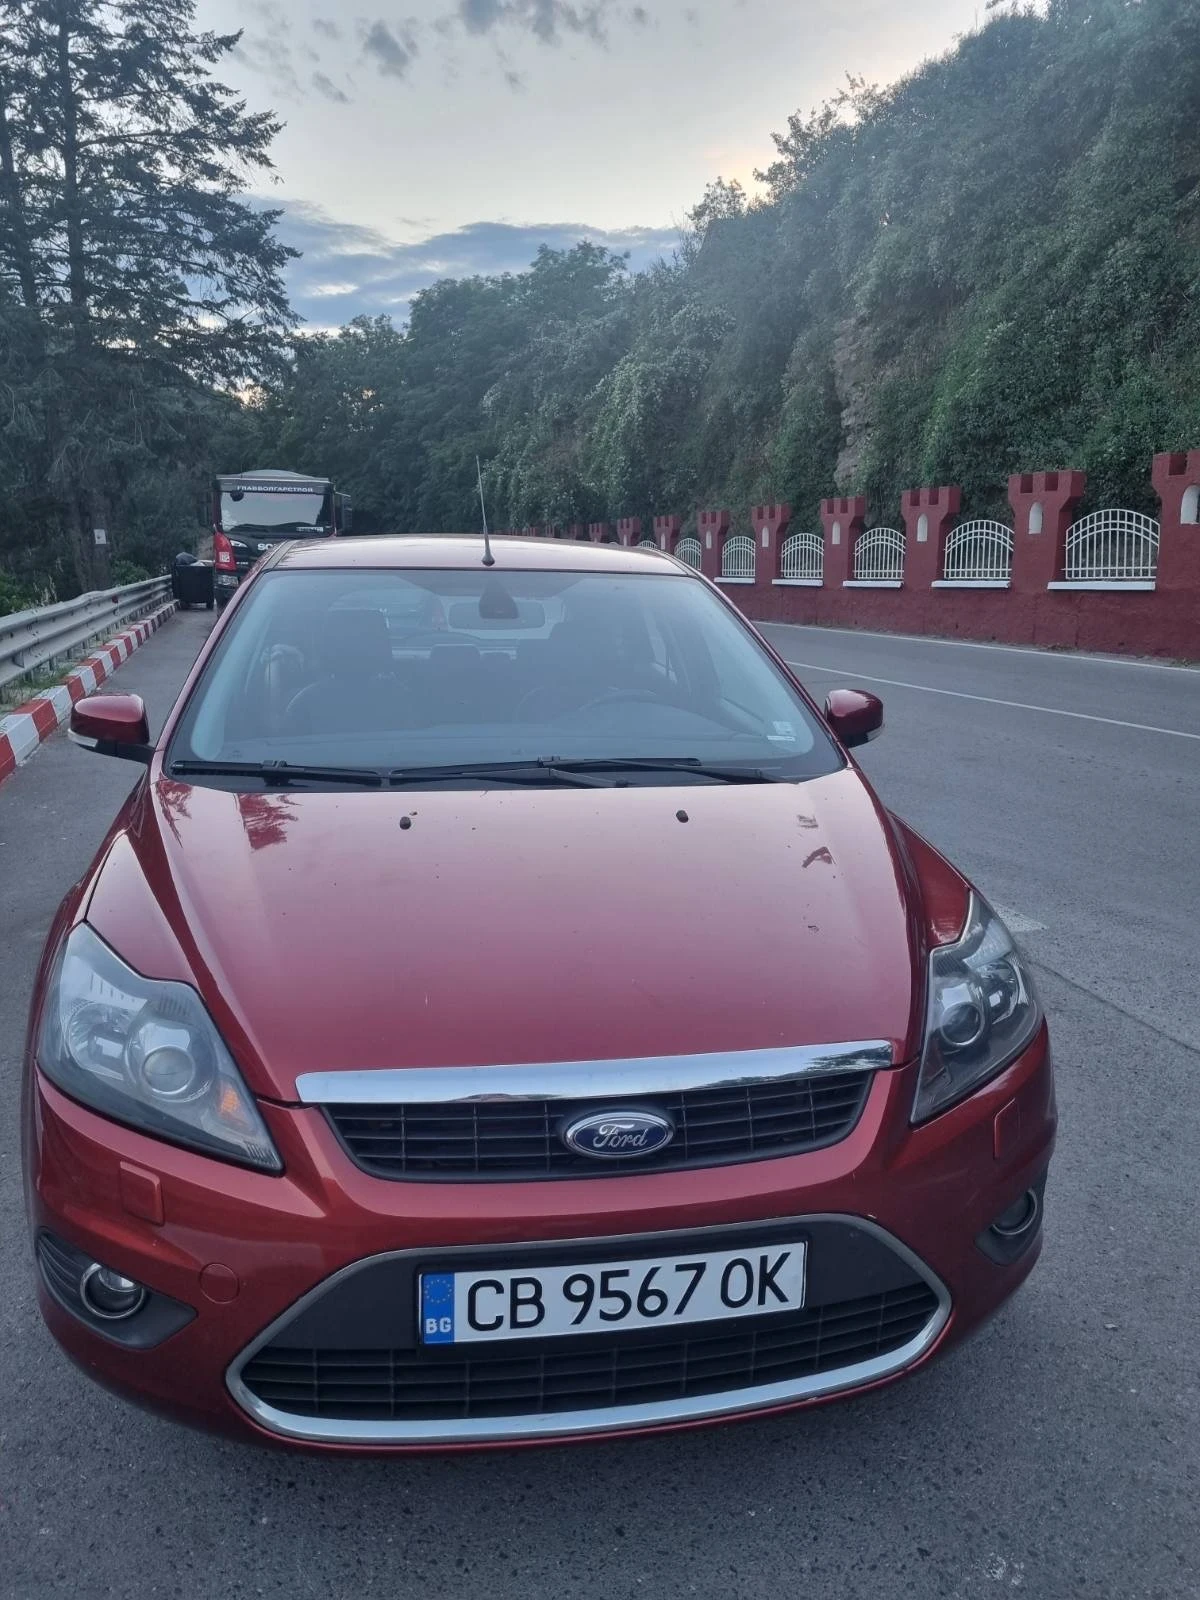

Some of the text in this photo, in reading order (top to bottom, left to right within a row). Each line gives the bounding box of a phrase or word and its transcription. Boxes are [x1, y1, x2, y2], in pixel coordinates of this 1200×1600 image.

[592, 1123, 649, 1148] Ford
[467, 1252, 791, 1332] CB 9567 OK
[424, 1317, 452, 1335] BG
